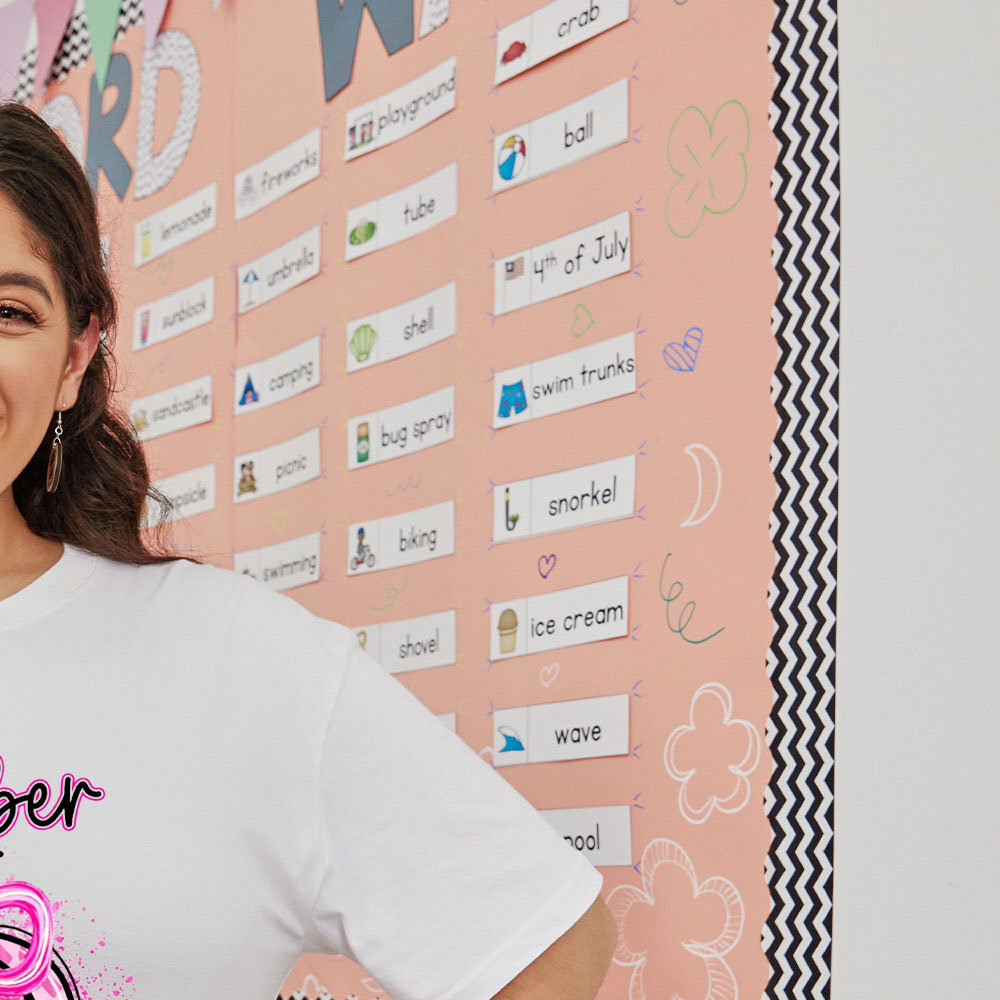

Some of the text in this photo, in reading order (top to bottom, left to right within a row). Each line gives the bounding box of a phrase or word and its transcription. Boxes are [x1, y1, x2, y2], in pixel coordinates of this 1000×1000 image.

[557, 0, 600, 38] crab
[378, 66, 456, 136] playground
[564, 110, 594, 149] ball
[261, 149, 317, 192] fireworks
[160, 201, 212, 240] lemonade
[404, 195, 436, 225] tube
[267, 247, 314, 287] umbrella
[533, 231, 629, 284] 4th of July
[162, 295, 208, 329] sunblock
[403, 306, 434, 341] shell
[269, 361, 313, 392] camping
[532, 352, 635, 400] swim trunks
[381, 411, 451, 449] bug spray
[276, 456, 307, 485] picnic
[548, 476, 618, 516] snorkel
[399, 529, 437, 552] biking
[263, 554, 317, 583] swimming
[530, 604, 623, 638] ice cream
[399, 627, 439, 659] shovel
[555, 725, 601, 745] wave
